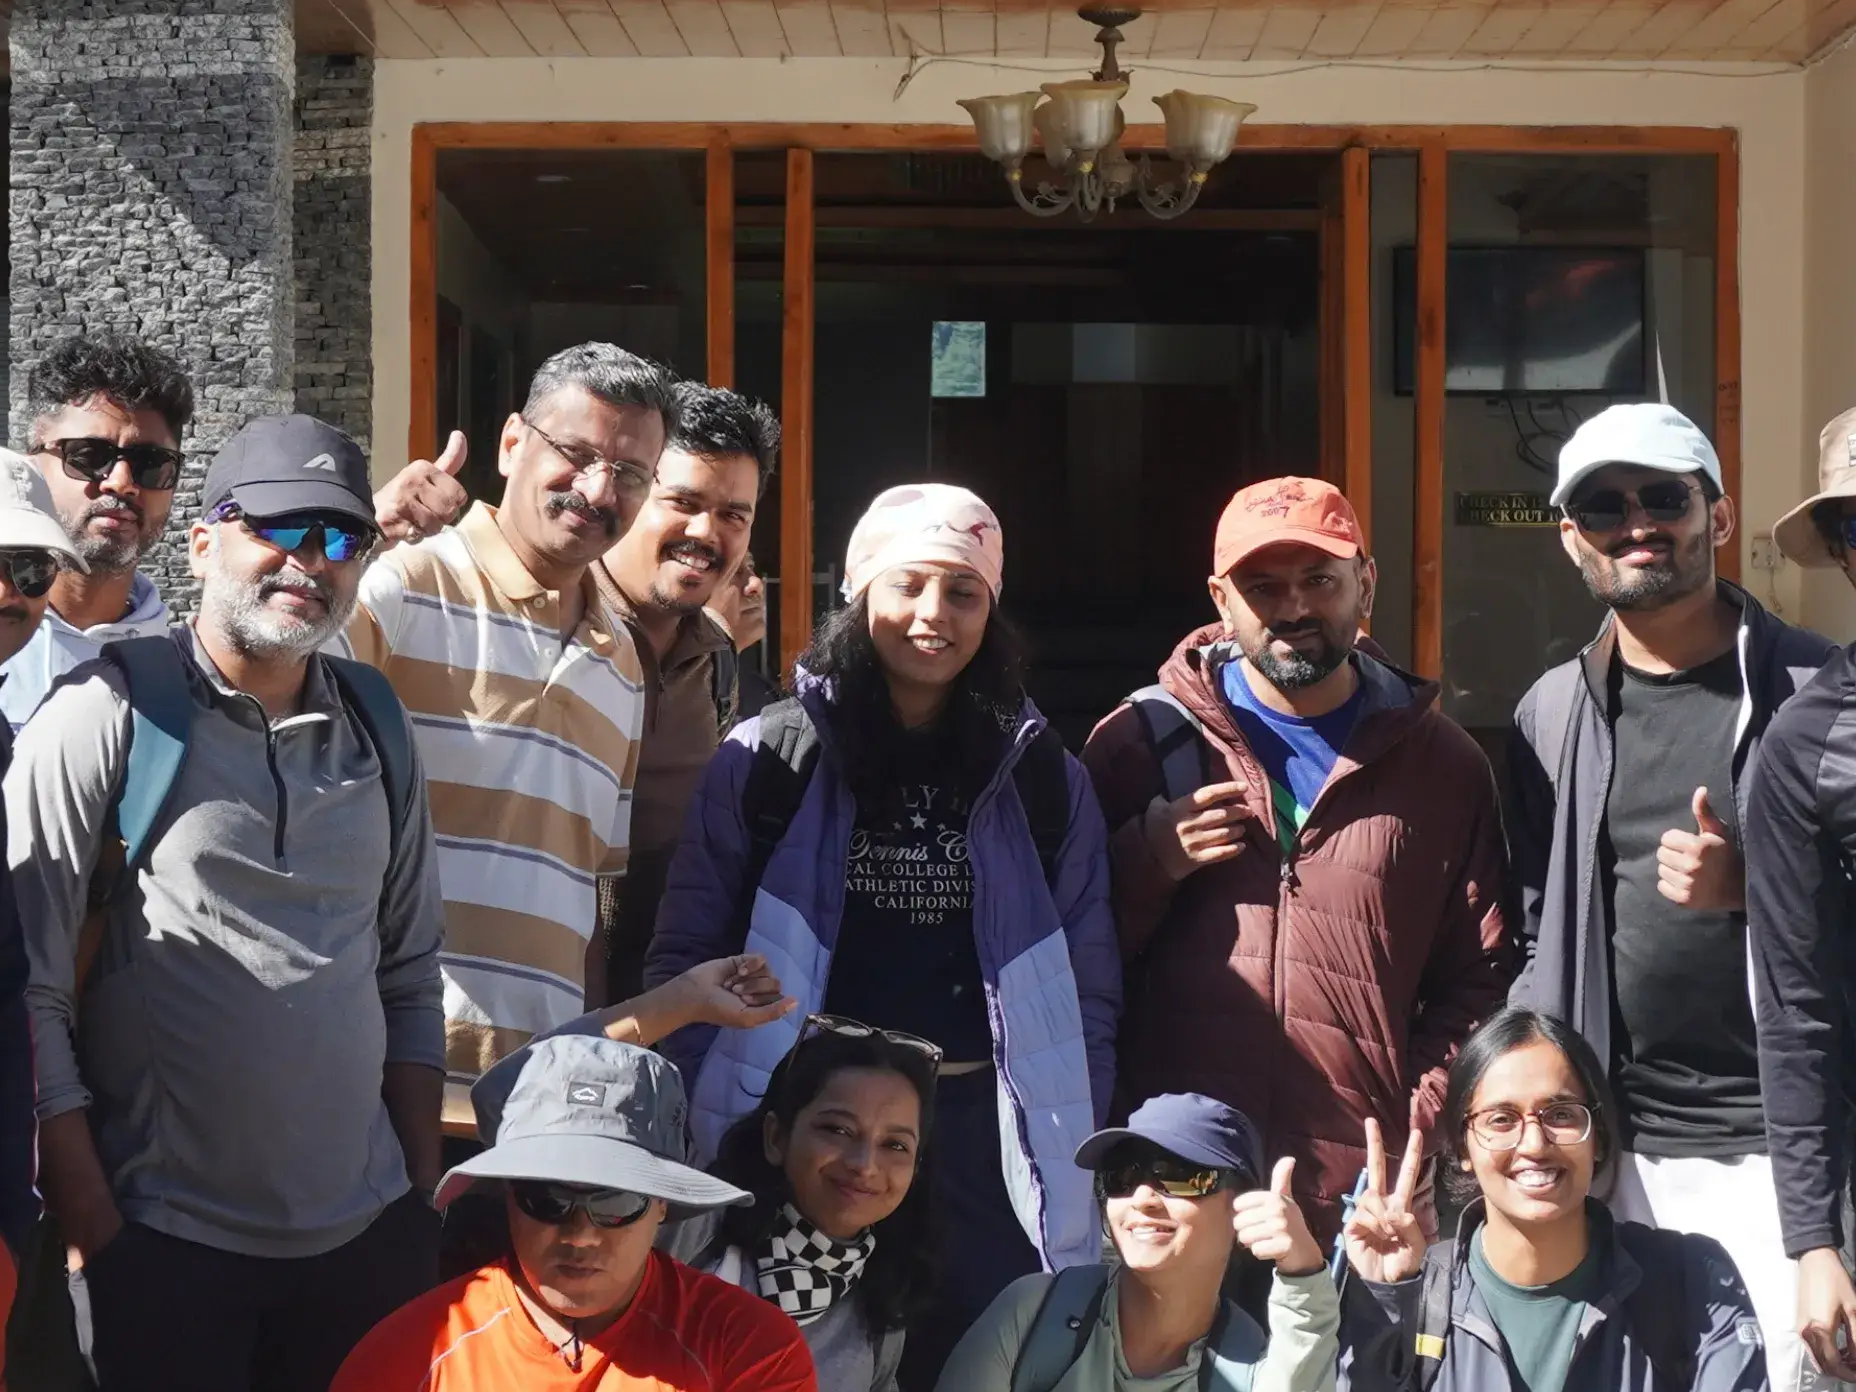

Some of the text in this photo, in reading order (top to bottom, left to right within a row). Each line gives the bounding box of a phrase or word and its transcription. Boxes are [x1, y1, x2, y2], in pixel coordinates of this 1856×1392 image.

[1509, 496, 1528, 509] IN
[1514, 510, 1544, 522] OUT
[881, 863, 958, 876] COLLEGE
[845, 878, 927, 893] ATHLETIC
[874, 895, 973, 909] CALIFORNI
[910, 911, 943, 925] 1985
